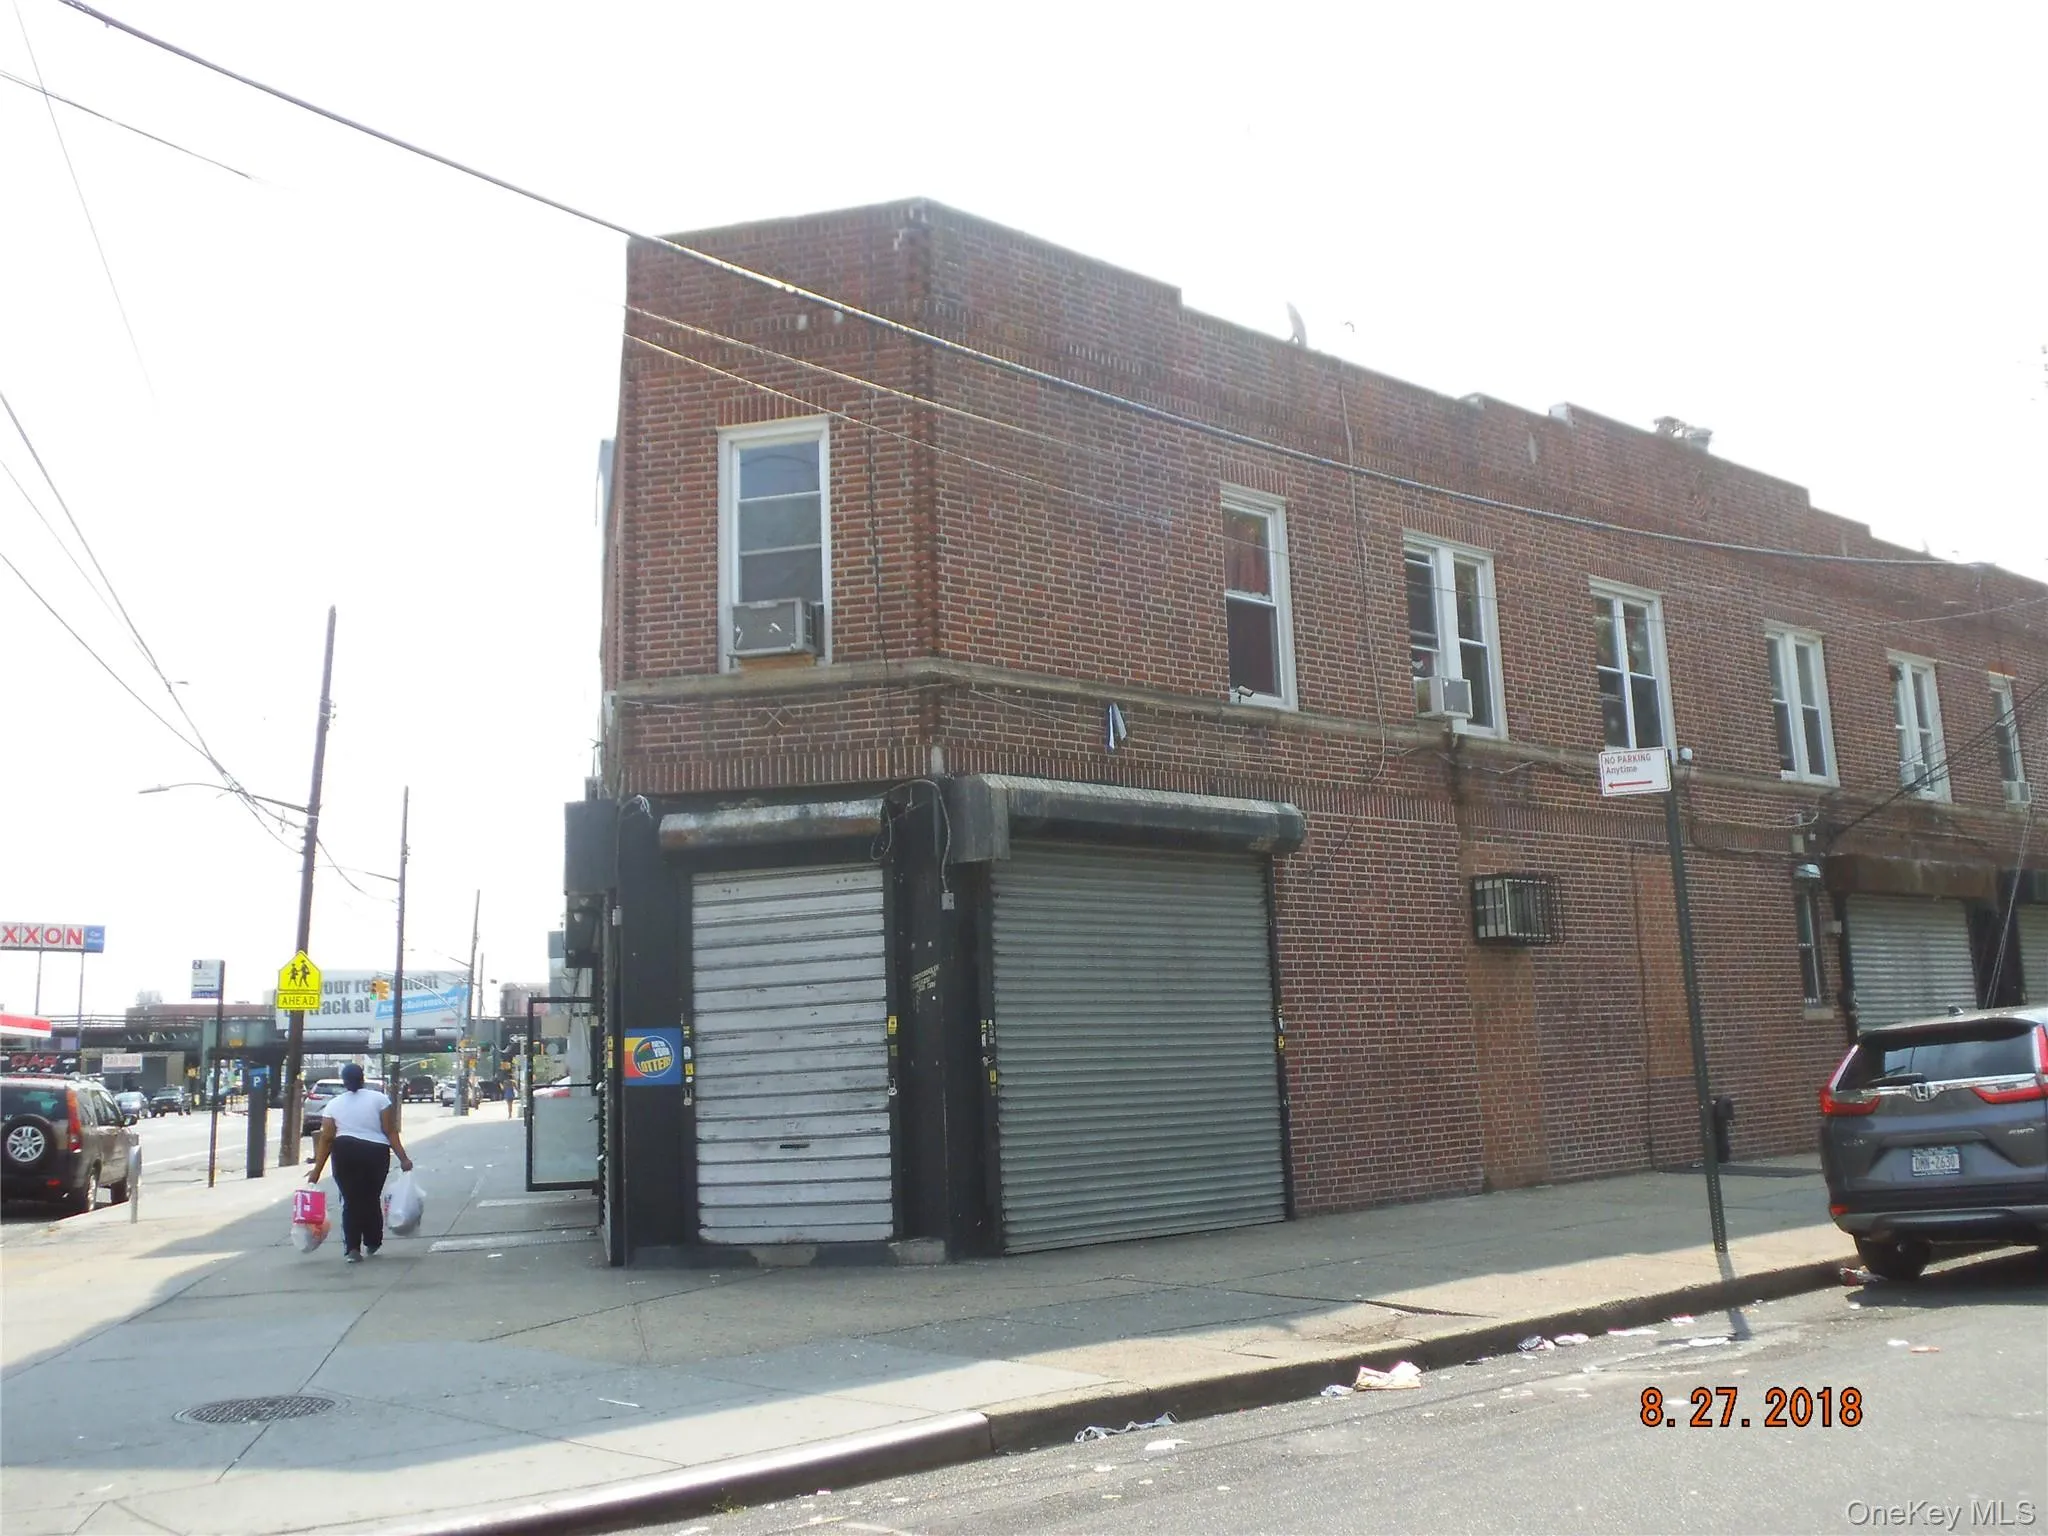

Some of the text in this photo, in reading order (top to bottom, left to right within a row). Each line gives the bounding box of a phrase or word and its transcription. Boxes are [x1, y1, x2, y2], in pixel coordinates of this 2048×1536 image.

[1604, 753, 1651, 765] NO PARKING
[1606, 765, 1638, 776] Anytime
[320, 980, 350, 994] our
[281, 996, 316, 1006] AHEAD
[309, 997, 351, 1015] ack
[354, 997, 370, 1013] at
